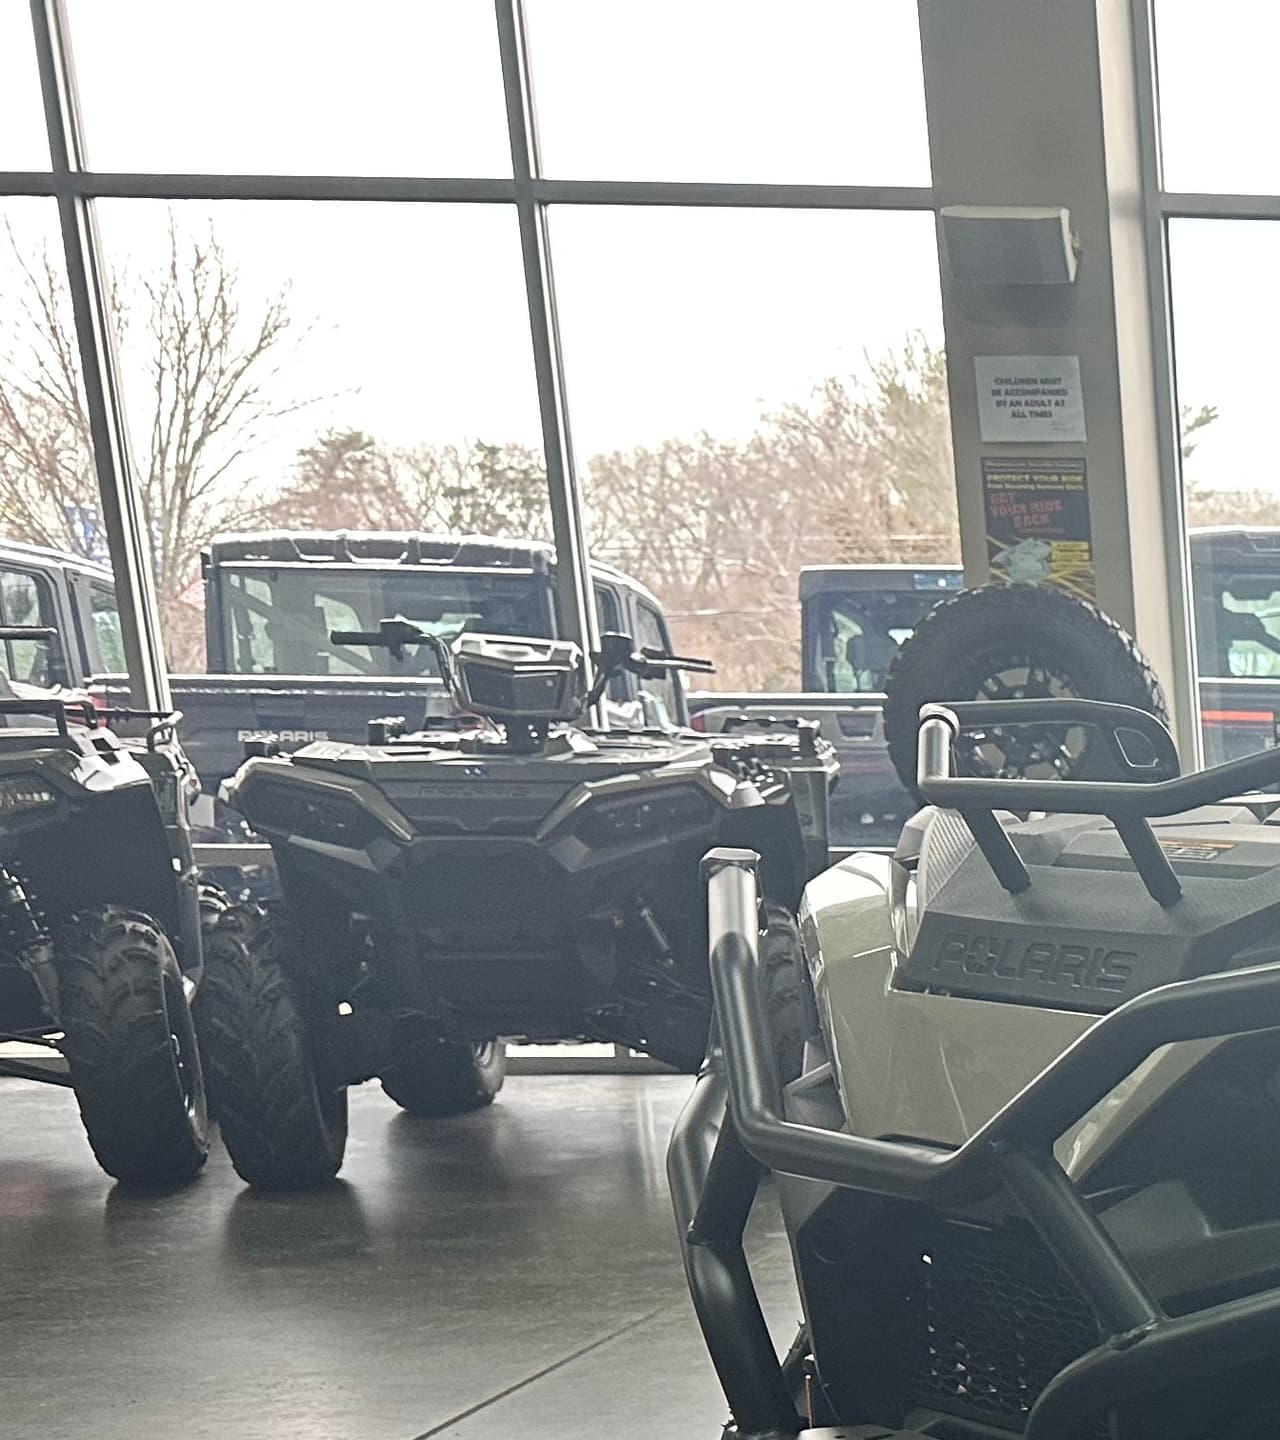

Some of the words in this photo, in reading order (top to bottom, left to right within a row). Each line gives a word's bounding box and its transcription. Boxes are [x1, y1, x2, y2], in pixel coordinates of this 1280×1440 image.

[993, 377, 1038, 386] CHILDREN
[1004, 388, 1069, 397] ACCOMPANIED
[1009, 399, 1022, 408] AN
[1024, 399, 1052, 408] ADULT
[1011, 410, 1027, 418] ALL
[1028, 410, 1053, 419] TIMES
[932, 932, 1138, 993] POLARIS
